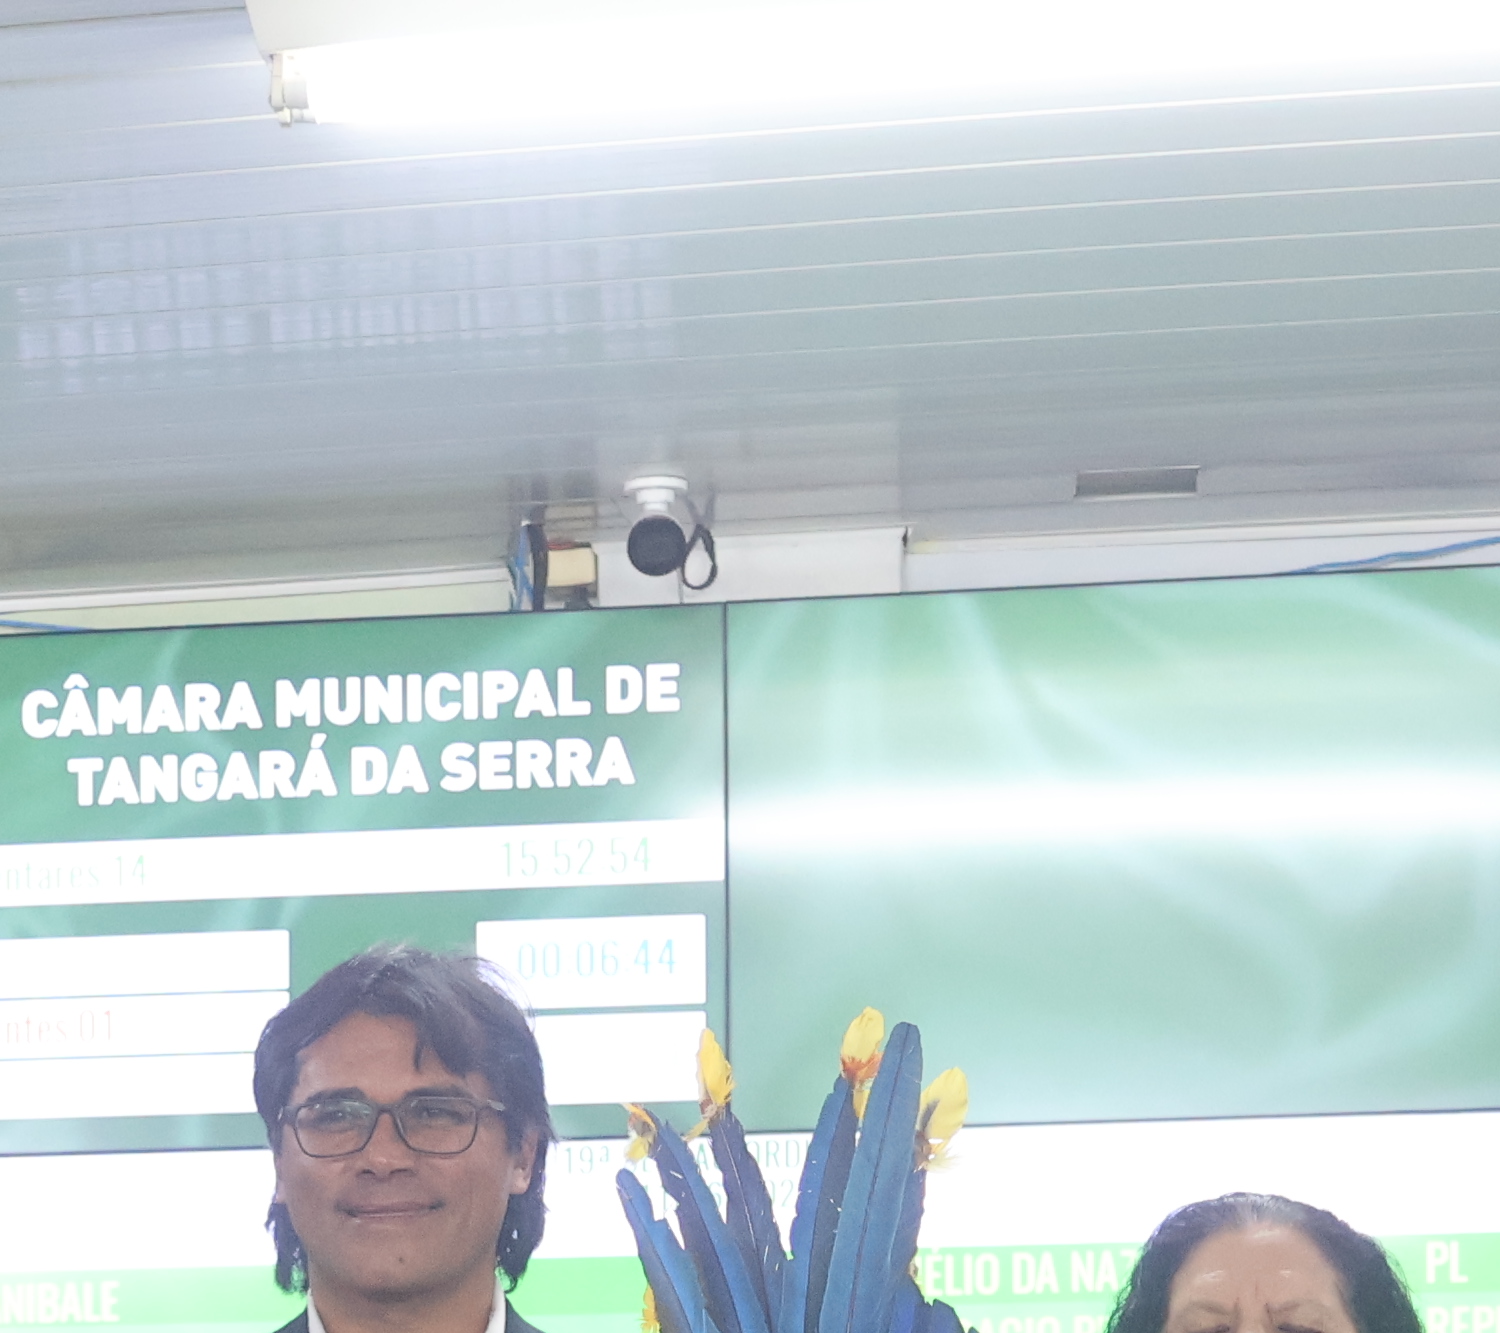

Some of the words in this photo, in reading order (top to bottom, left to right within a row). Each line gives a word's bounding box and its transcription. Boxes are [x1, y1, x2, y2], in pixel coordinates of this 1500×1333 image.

[21, 673, 262, 740] CÂMARA
[274, 666, 592, 729] MUNICIPAL
[605, 662, 681, 714] DE
[67, 733, 337, 807] TANGARÁ
[350, 744, 429, 796] DA
[439, 736, 635, 793] SERRA
[115, 854, 147, 888] 14
[78, 1010, 113, 1041] 01
[921, 1246, 999, 1297] ÉLIO
[1012, 1251, 1059, 1295] DA
[1425, 1241, 1469, 1284] PL
